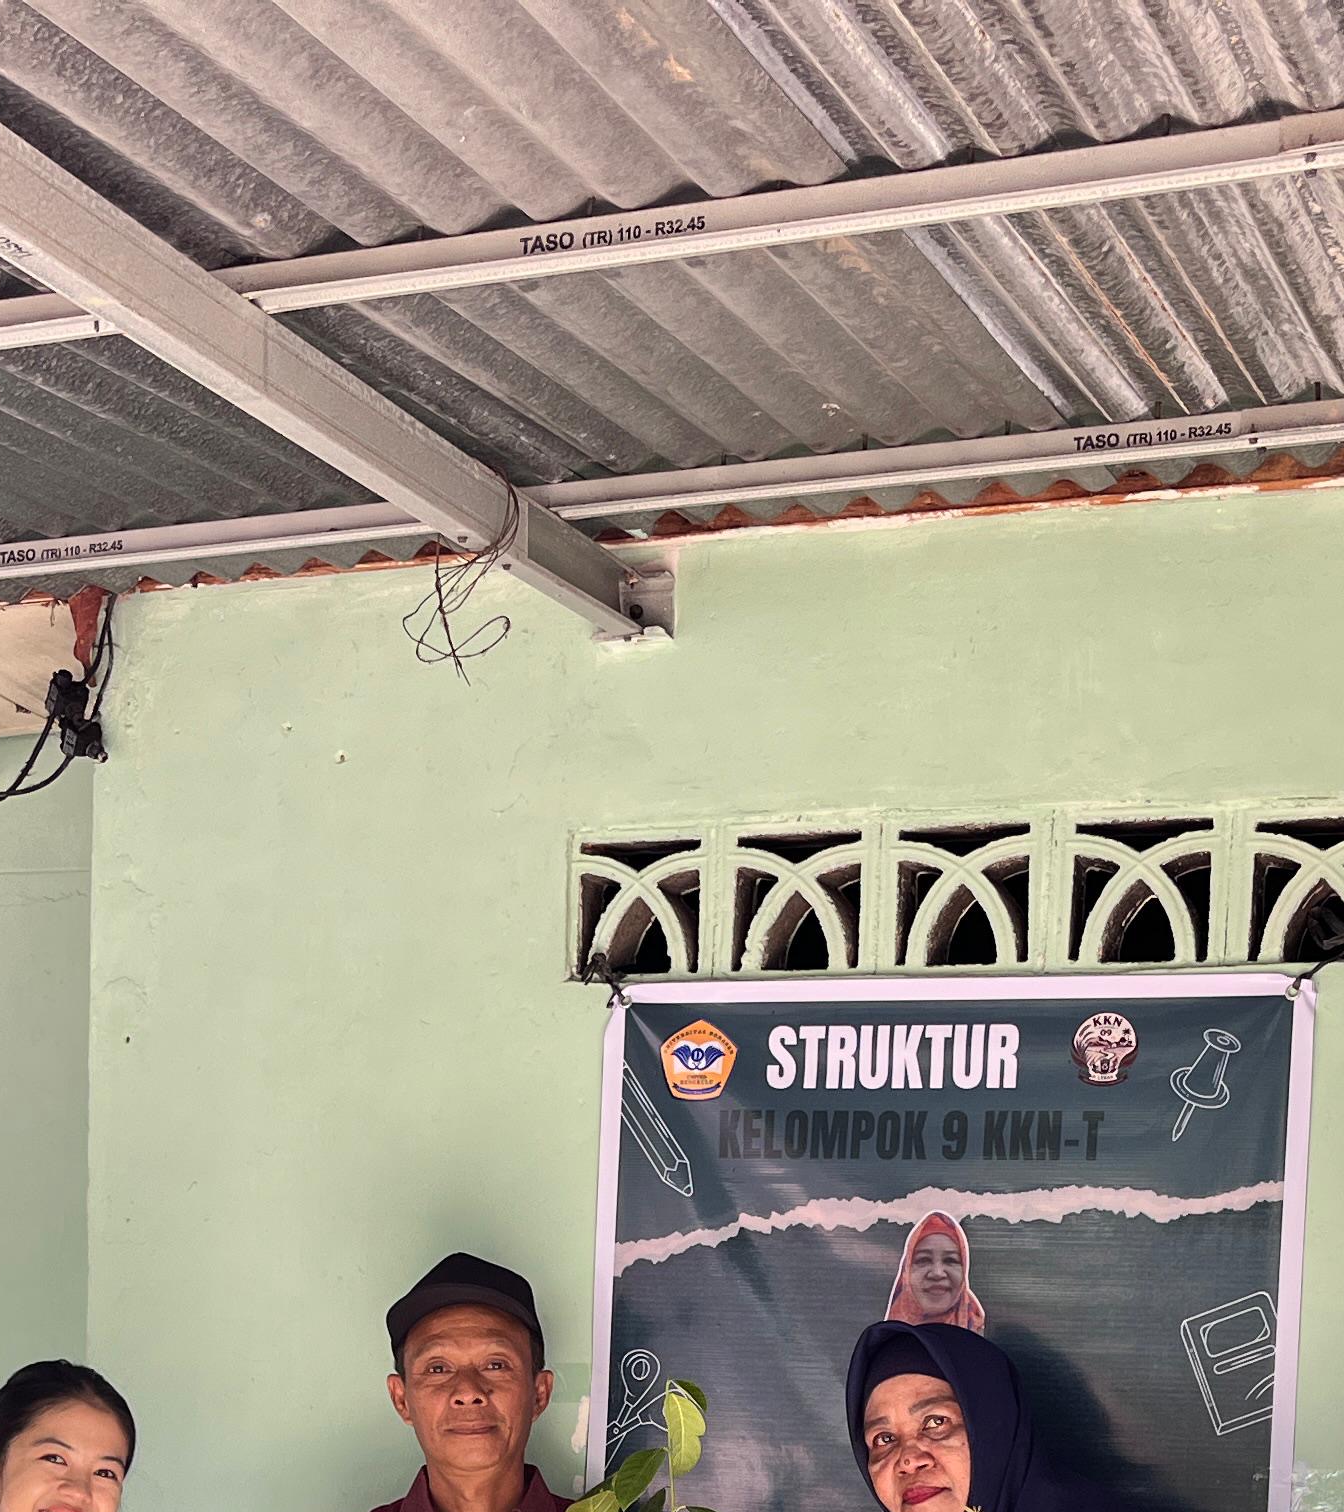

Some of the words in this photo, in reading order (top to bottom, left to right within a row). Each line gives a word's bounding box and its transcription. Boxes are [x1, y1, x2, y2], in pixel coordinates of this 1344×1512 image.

[520, 231, 575, 255] TASO
[582, 229, 613, 248] (TR)
[617, 225, 641, 241] 110
[655, 215, 706, 236] R32.45
[1074, 433, 1119, 451] TASO
[1127, 432, 1152, 447] (TR)
[1156, 429, 1177, 442] 110
[1188, 422, 1232, 439] R32.45
[0, 549, 36, 564] TASO
[41, 548, 62, 560] (TR)
[64, 545, 80, 557] 110
[89, 540, 123, 553] R32.45
[1093, 1015, 1123, 1027] KKN
[766, 1023, 1020, 1090] STRUKTUR
[718, 1109, 928, 1161] KELOMPOK
[941, 1109, 968, 1161] 9
[983, 1109, 1105, 1161] KKN-T
